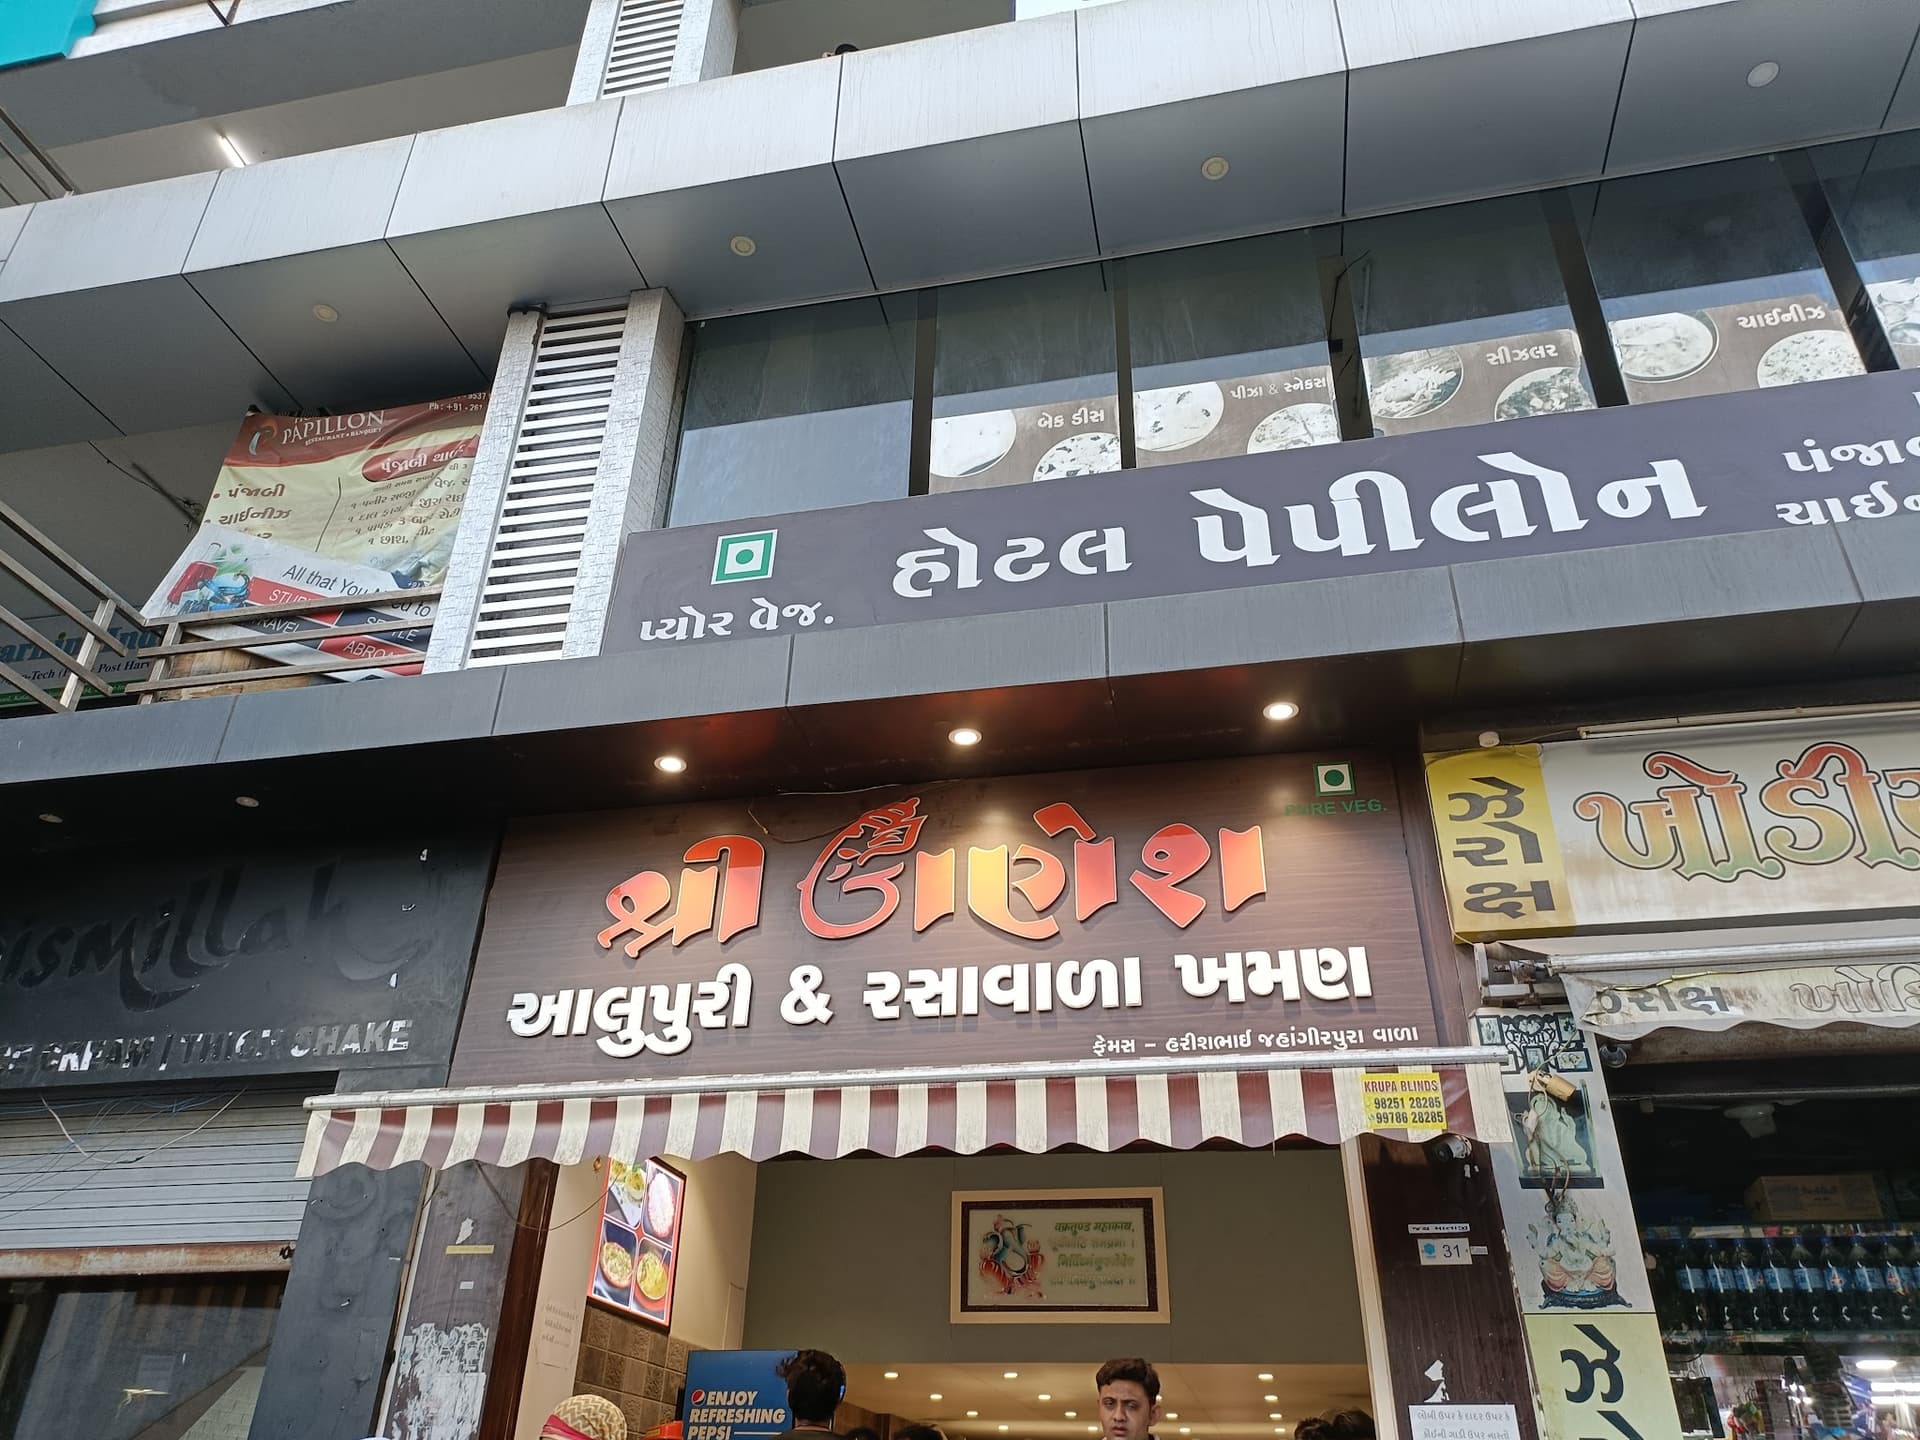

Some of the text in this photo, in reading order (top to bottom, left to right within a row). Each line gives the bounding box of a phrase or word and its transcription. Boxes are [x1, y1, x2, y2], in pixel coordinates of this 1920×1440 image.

[1268, 383, 1279, 395] &
[282, 409, 386, 445] PAPILLON
[228, 484, 286, 498] પંજાબી
[219, 507, 293, 525] ચાઈનીઝ
[892, 451, 1708, 598] હોટલ પેપીલોન
[282, 564, 306, 581] All
[306, 570, 336, 591] that
[639, 597, 835, 642] પ્યોર વેજ.
[1284, 801, 1337, 816] PURE
[596, 796, 1267, 959] શ્રી ગણેશ
[506, 945, 1372, 1058] આલુપુરી & રસાવાળા ખમણ
[290, 1018, 414, 1058] SHAKE
[1165, 1028, 1252, 1053] હરીશભાઈ
[1372, 1025, 1419, 1042] વાળા
[1510, 1028, 1555, 1045] FAMILY
[1364, 1079, 1438, 1093] KRUPA BLINDS
[1374, 1096, 1441, 1109] 98251 28285
[1376, 1111, 1443, 1124] 99786 28285
[1442, 1244, 1460, 1258] 31
[706, 1391, 759, 1406] ENJOY
[689, 1408, 786, 1424] REFRESHING
[687, 1425, 732, 1440] PEPSI
